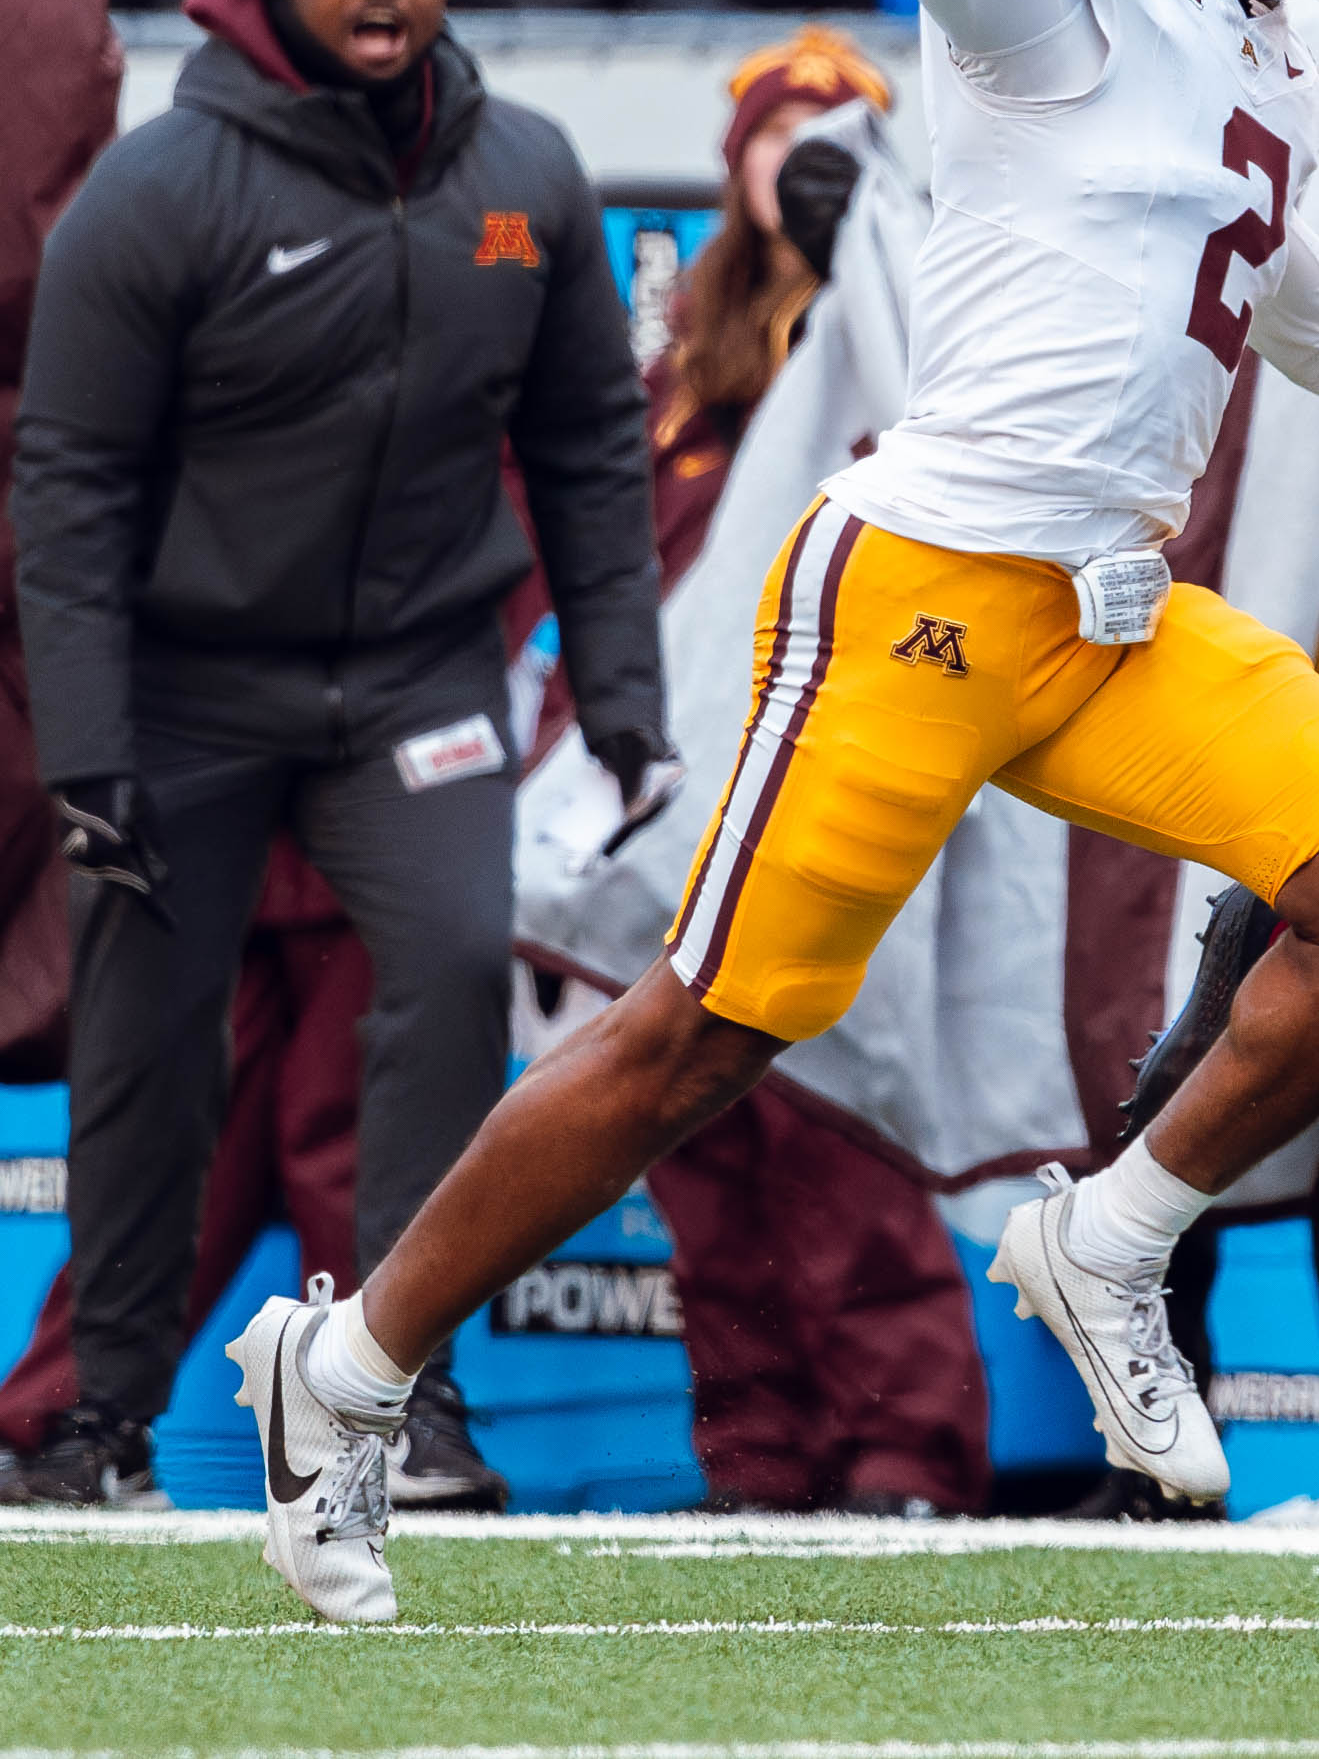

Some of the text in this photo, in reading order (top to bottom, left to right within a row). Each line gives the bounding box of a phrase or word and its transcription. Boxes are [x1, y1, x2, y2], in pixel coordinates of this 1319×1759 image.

[474, 211, 540, 267] M
[1185, 106, 1291, 374] 2
[890, 613, 970, 680] M
